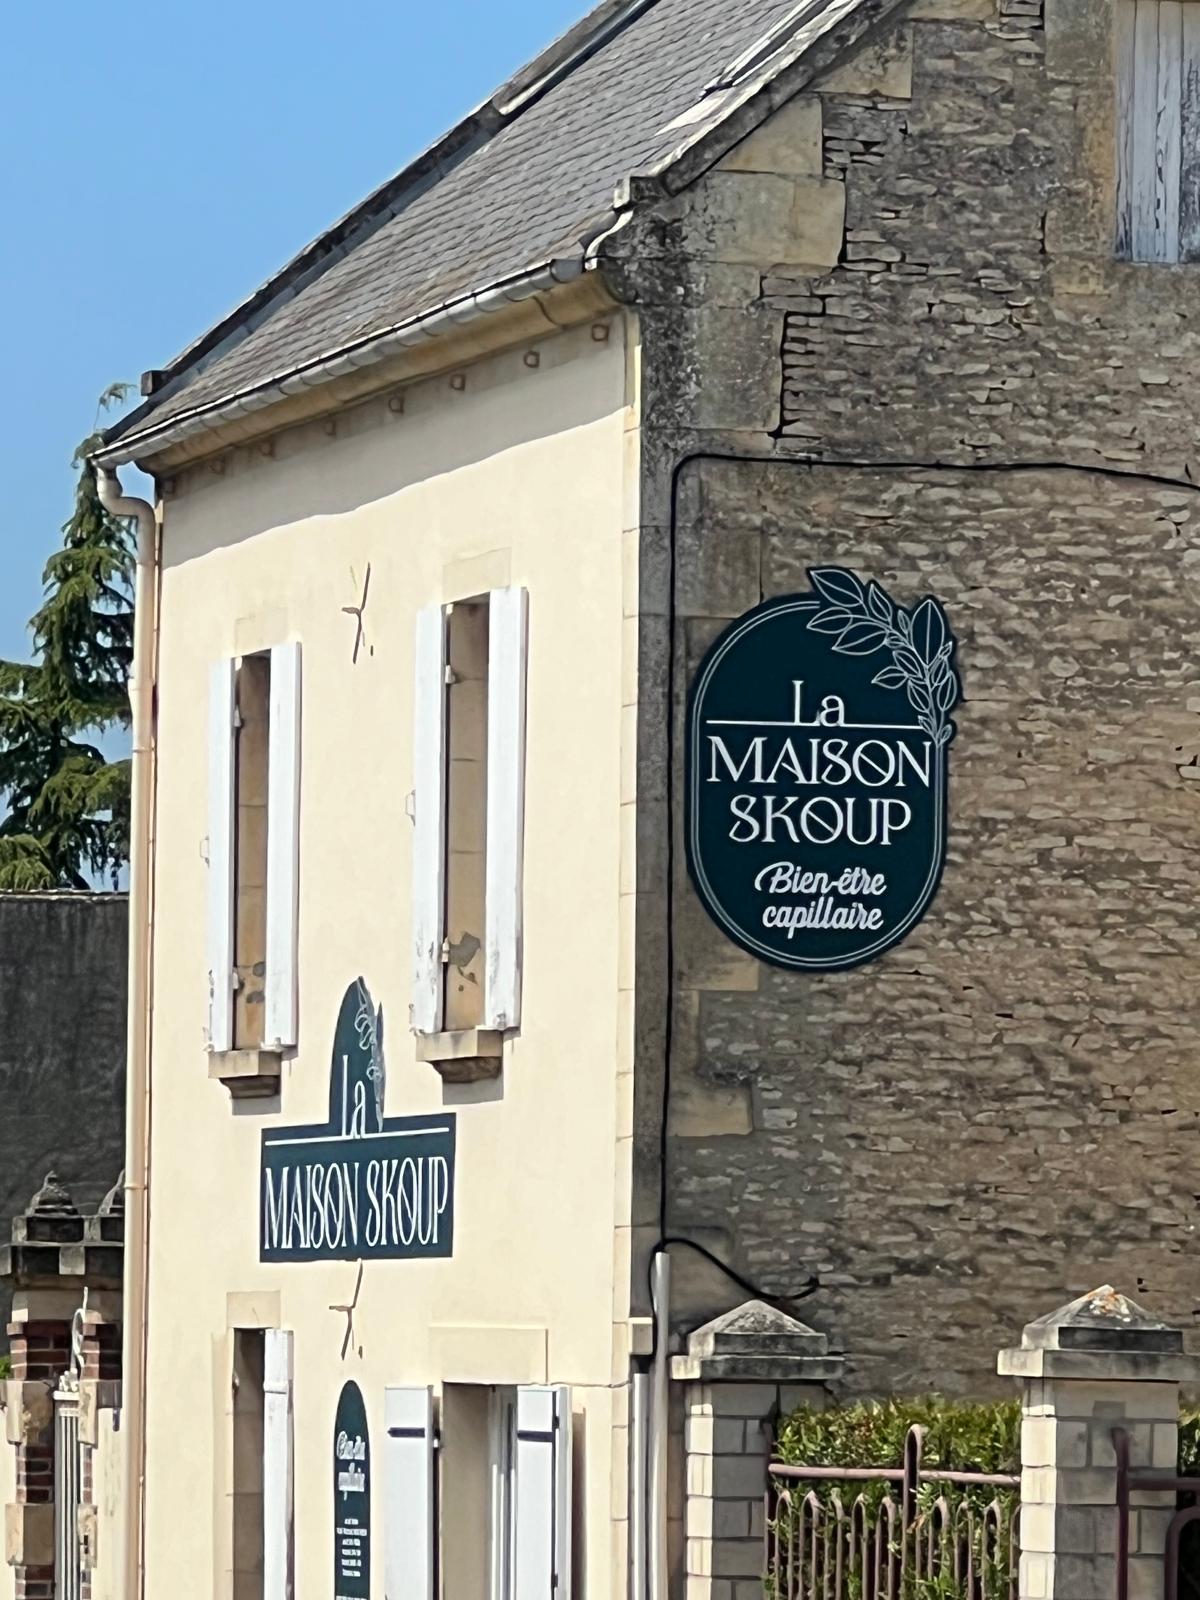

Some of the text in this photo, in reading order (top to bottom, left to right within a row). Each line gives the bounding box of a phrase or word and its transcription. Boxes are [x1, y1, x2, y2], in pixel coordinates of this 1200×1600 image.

[792, 680, 845, 727] La
[706, 735, 932, 788] MAISON
[729, 794, 912, 846] SKOUP
[755, 860, 887, 896] Bien-être
[762, 896, 884, 939] capillaire
[264, 1156, 449, 1250] MAISON SKOUP
